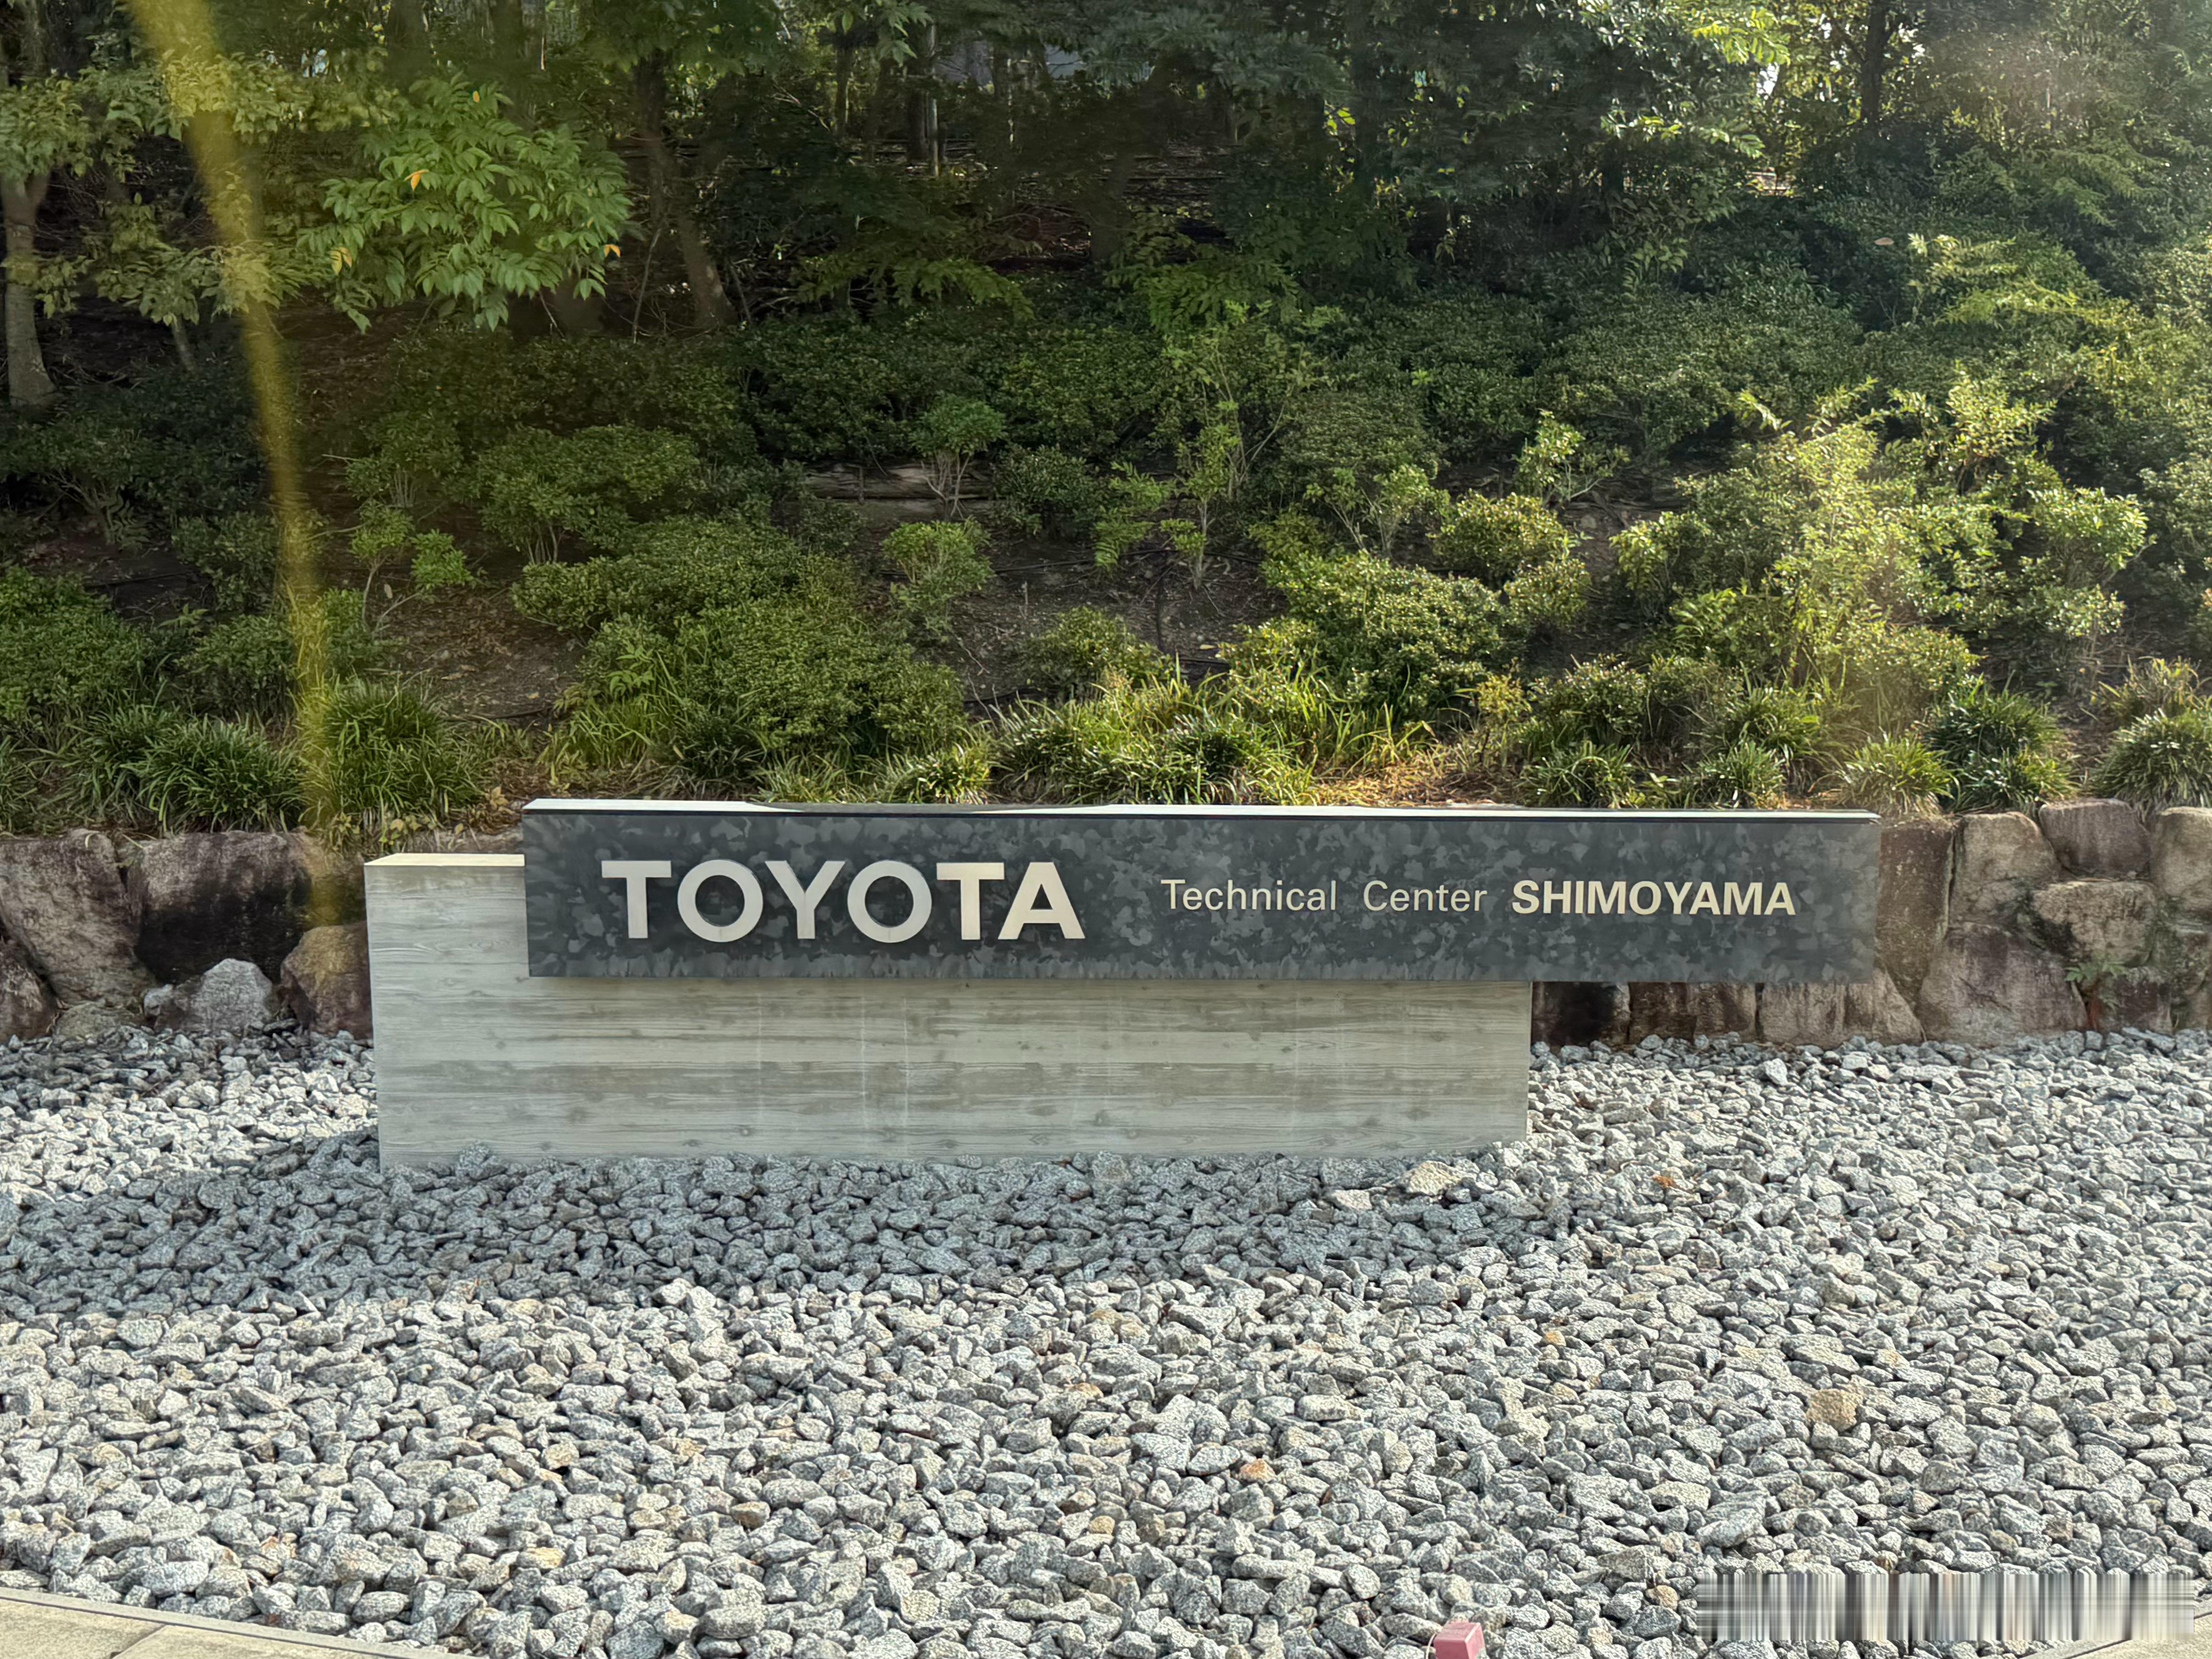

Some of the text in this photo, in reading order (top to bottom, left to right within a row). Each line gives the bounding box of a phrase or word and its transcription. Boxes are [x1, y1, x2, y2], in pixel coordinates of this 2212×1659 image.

[601, 859, 1796, 943] TOYOTA Technical Center SHIMOYAMA
